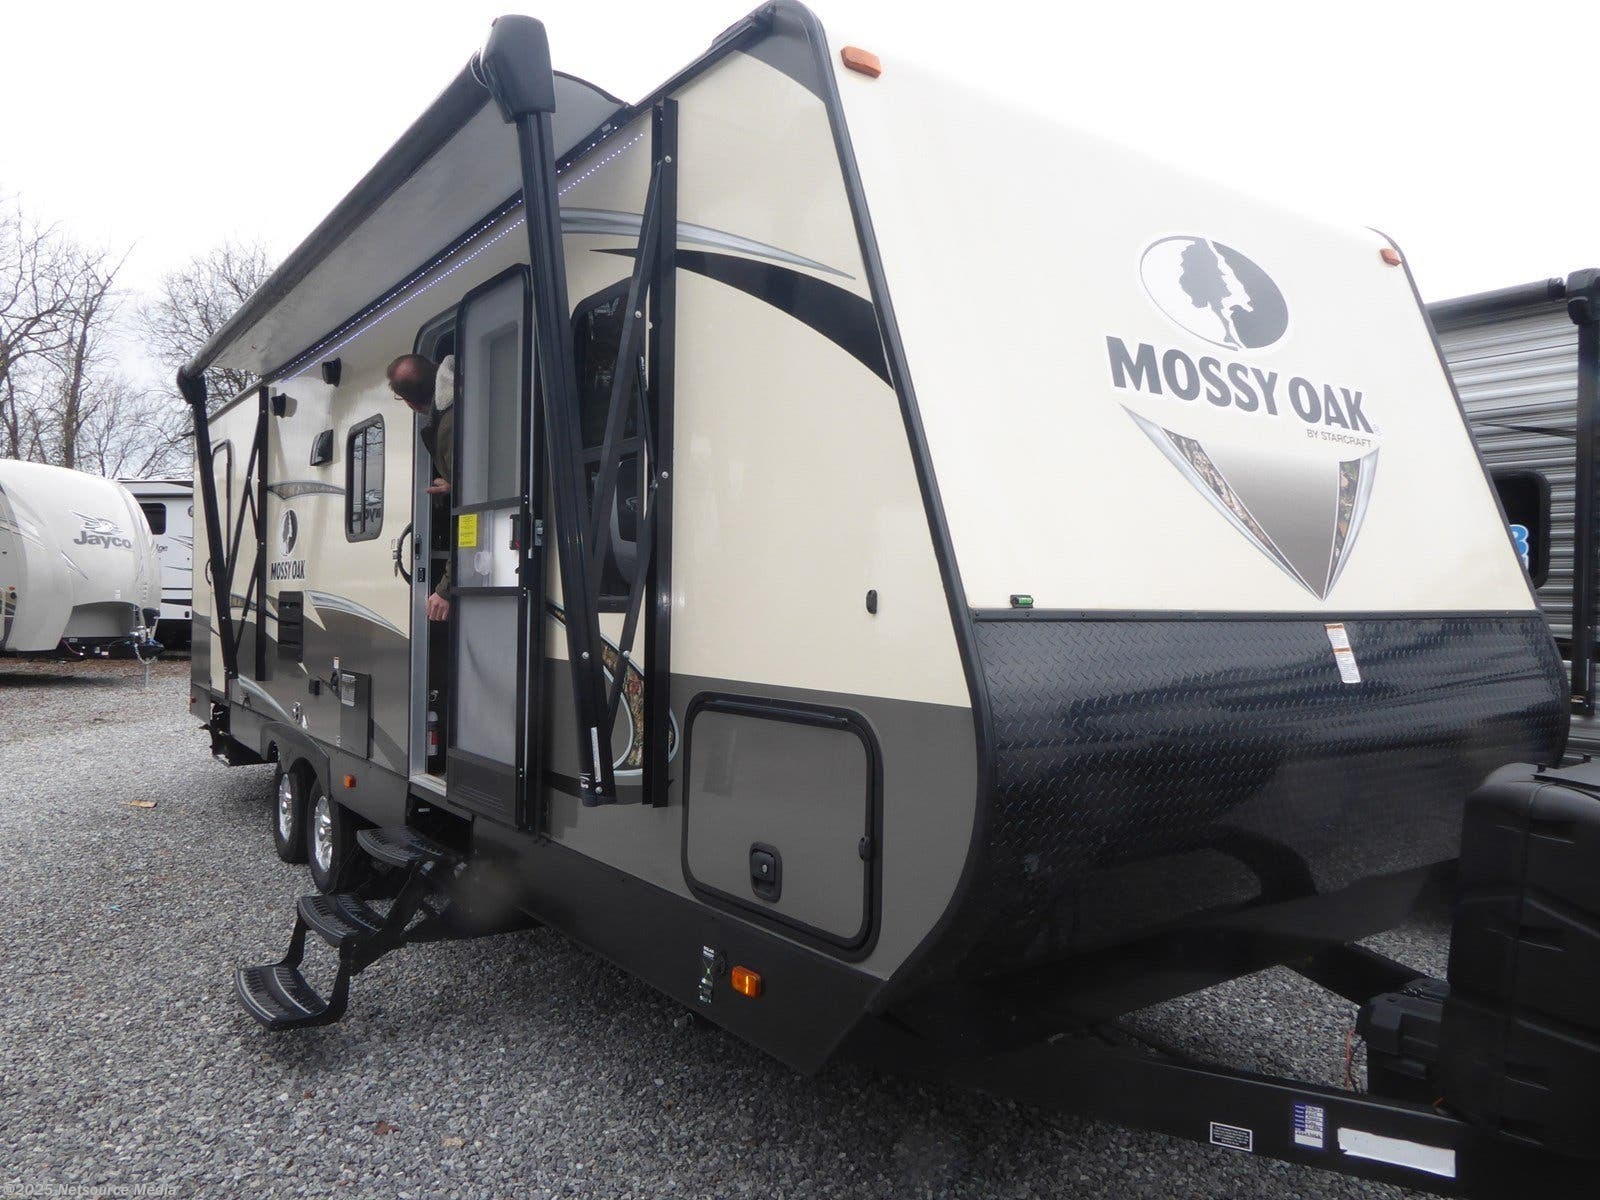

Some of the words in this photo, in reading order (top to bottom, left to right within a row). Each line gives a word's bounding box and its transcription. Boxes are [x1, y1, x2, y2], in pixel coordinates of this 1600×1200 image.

[1105, 336, 1278, 416] MOSSY
[1288, 376, 1375, 434] OAK
[1306, 429, 1319, 439] BY
[1321, 431, 1372, 447] STARCRAFT
[73, 531, 132, 550] Jayco
[270, 563, 292, 580] MOSSY
[292, 560, 306, 580] OAK
